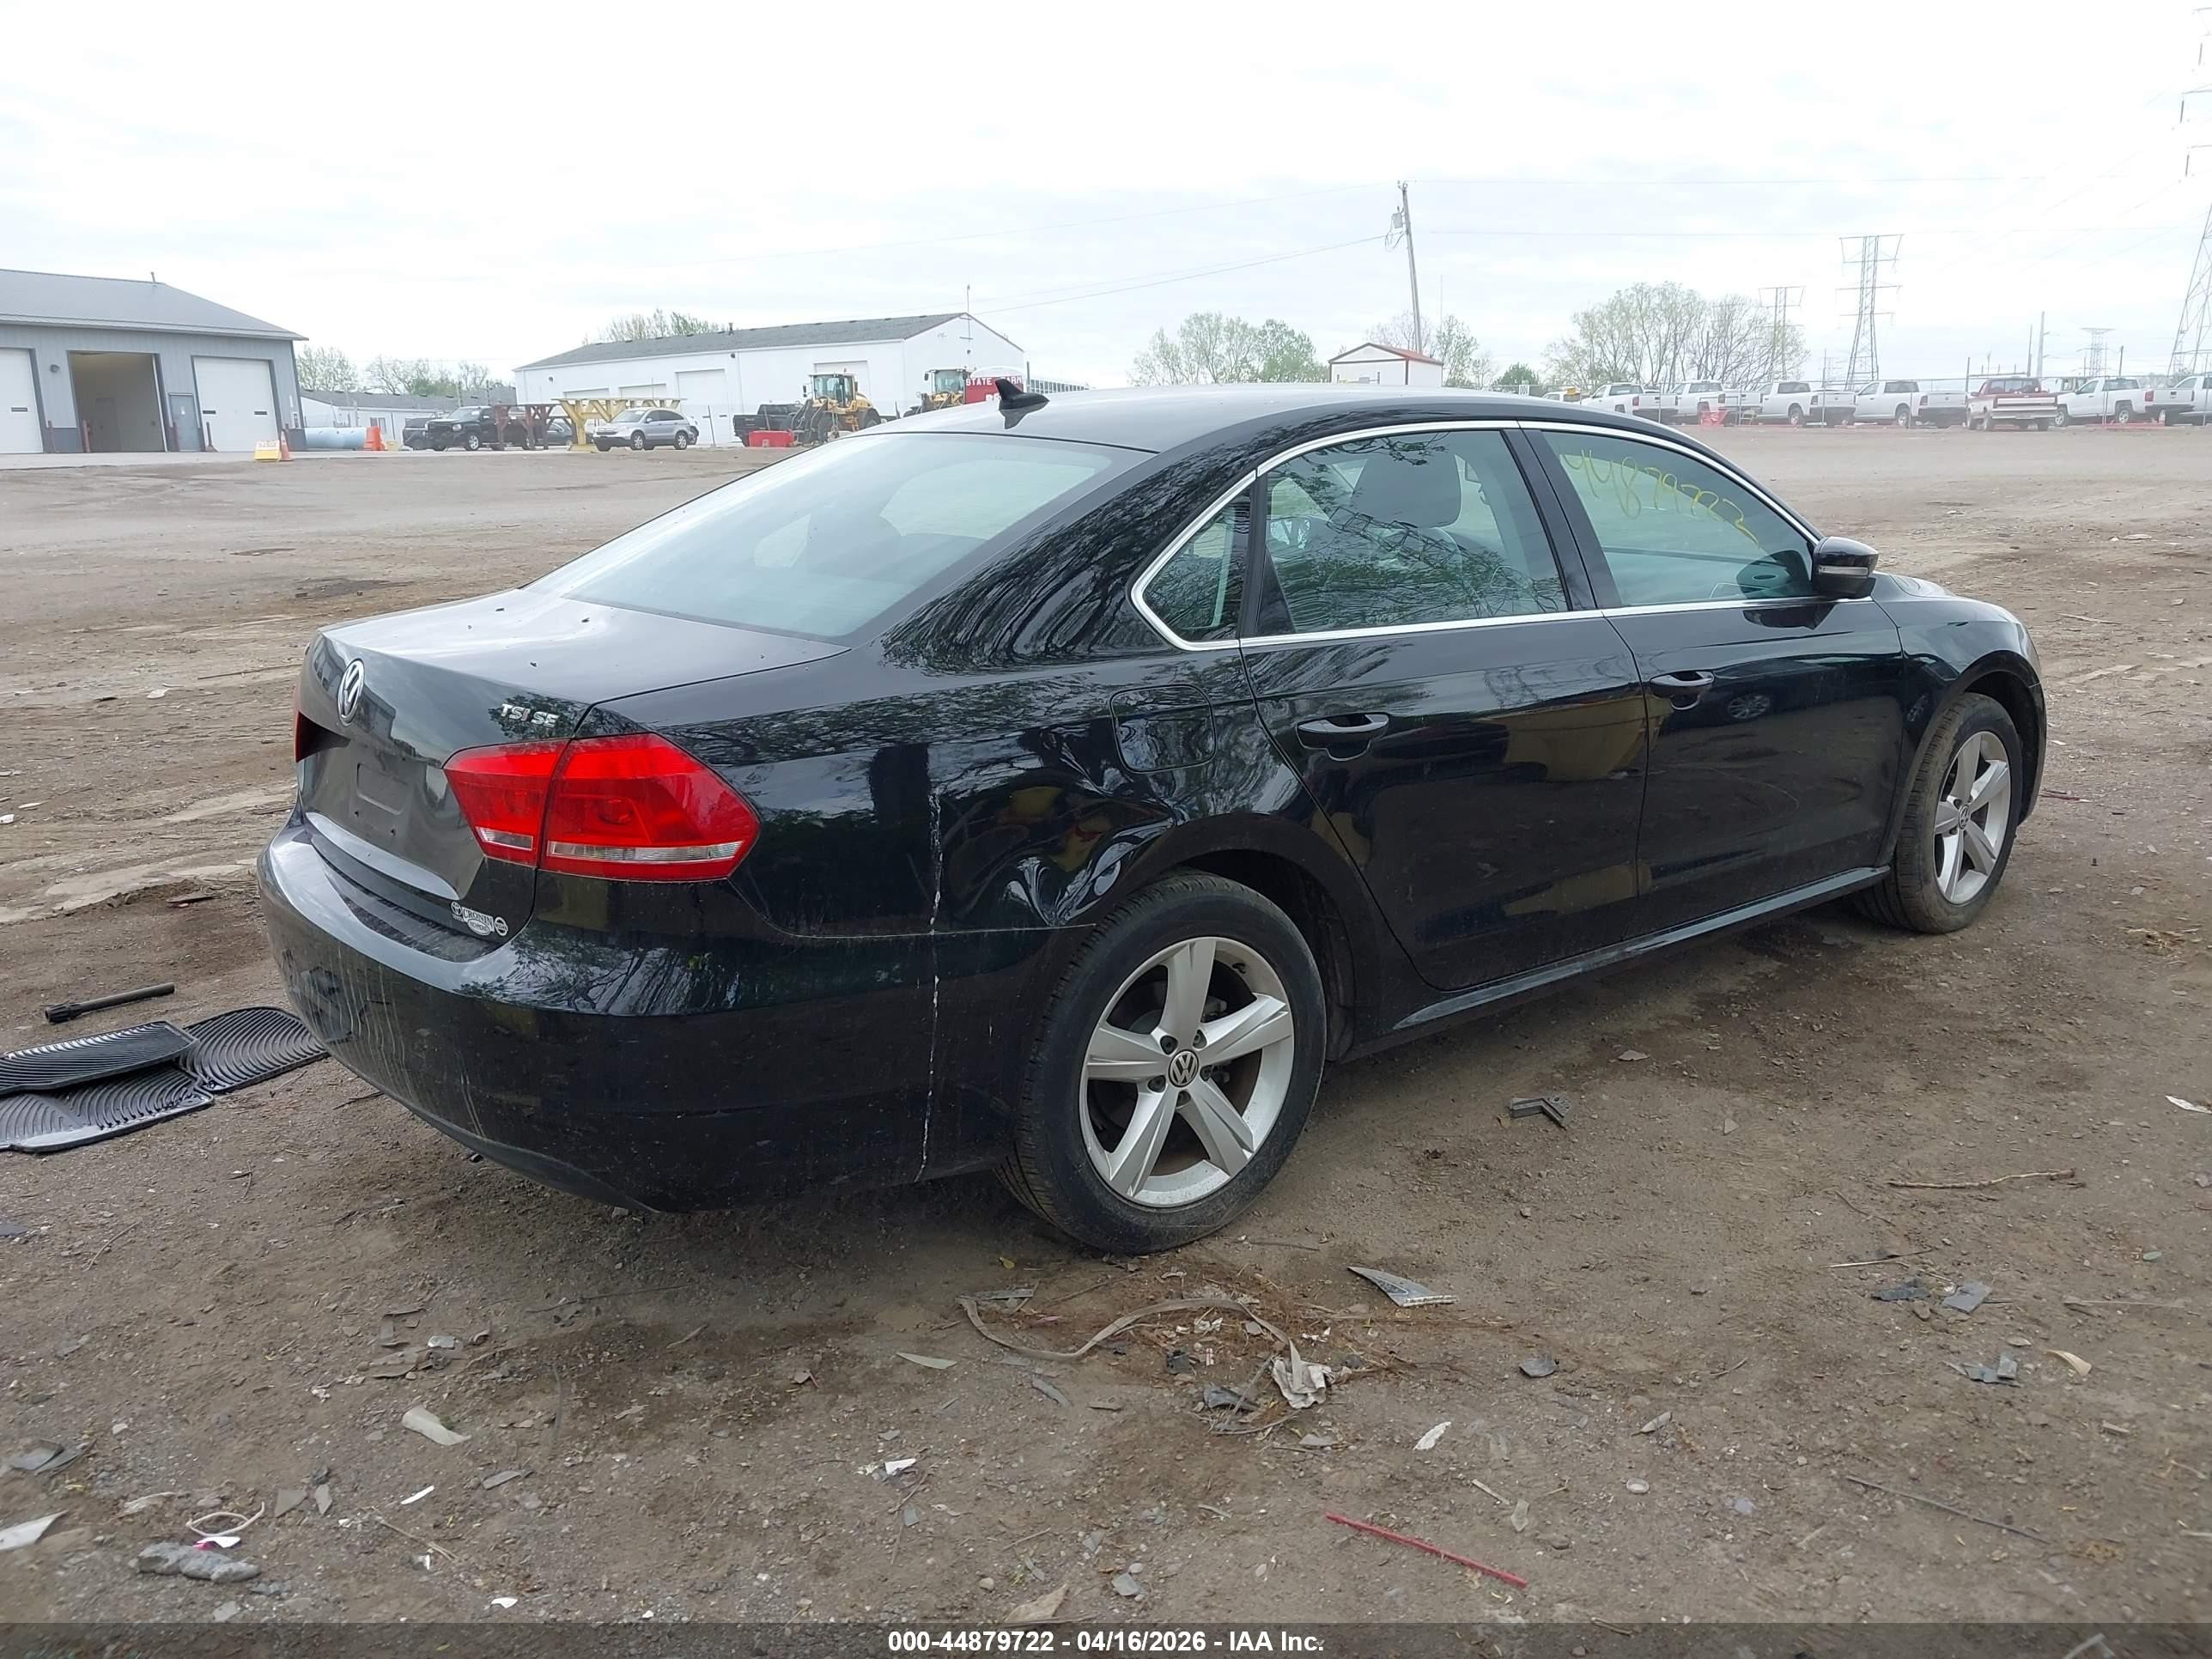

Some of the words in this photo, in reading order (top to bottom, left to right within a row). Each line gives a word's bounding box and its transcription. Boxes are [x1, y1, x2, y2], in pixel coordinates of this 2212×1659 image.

[965, 377, 993, 386] STATE
[501, 703, 531, 721] TSI
[531, 711, 560, 728] SE
[463, 908, 493, 929] CRONIN
